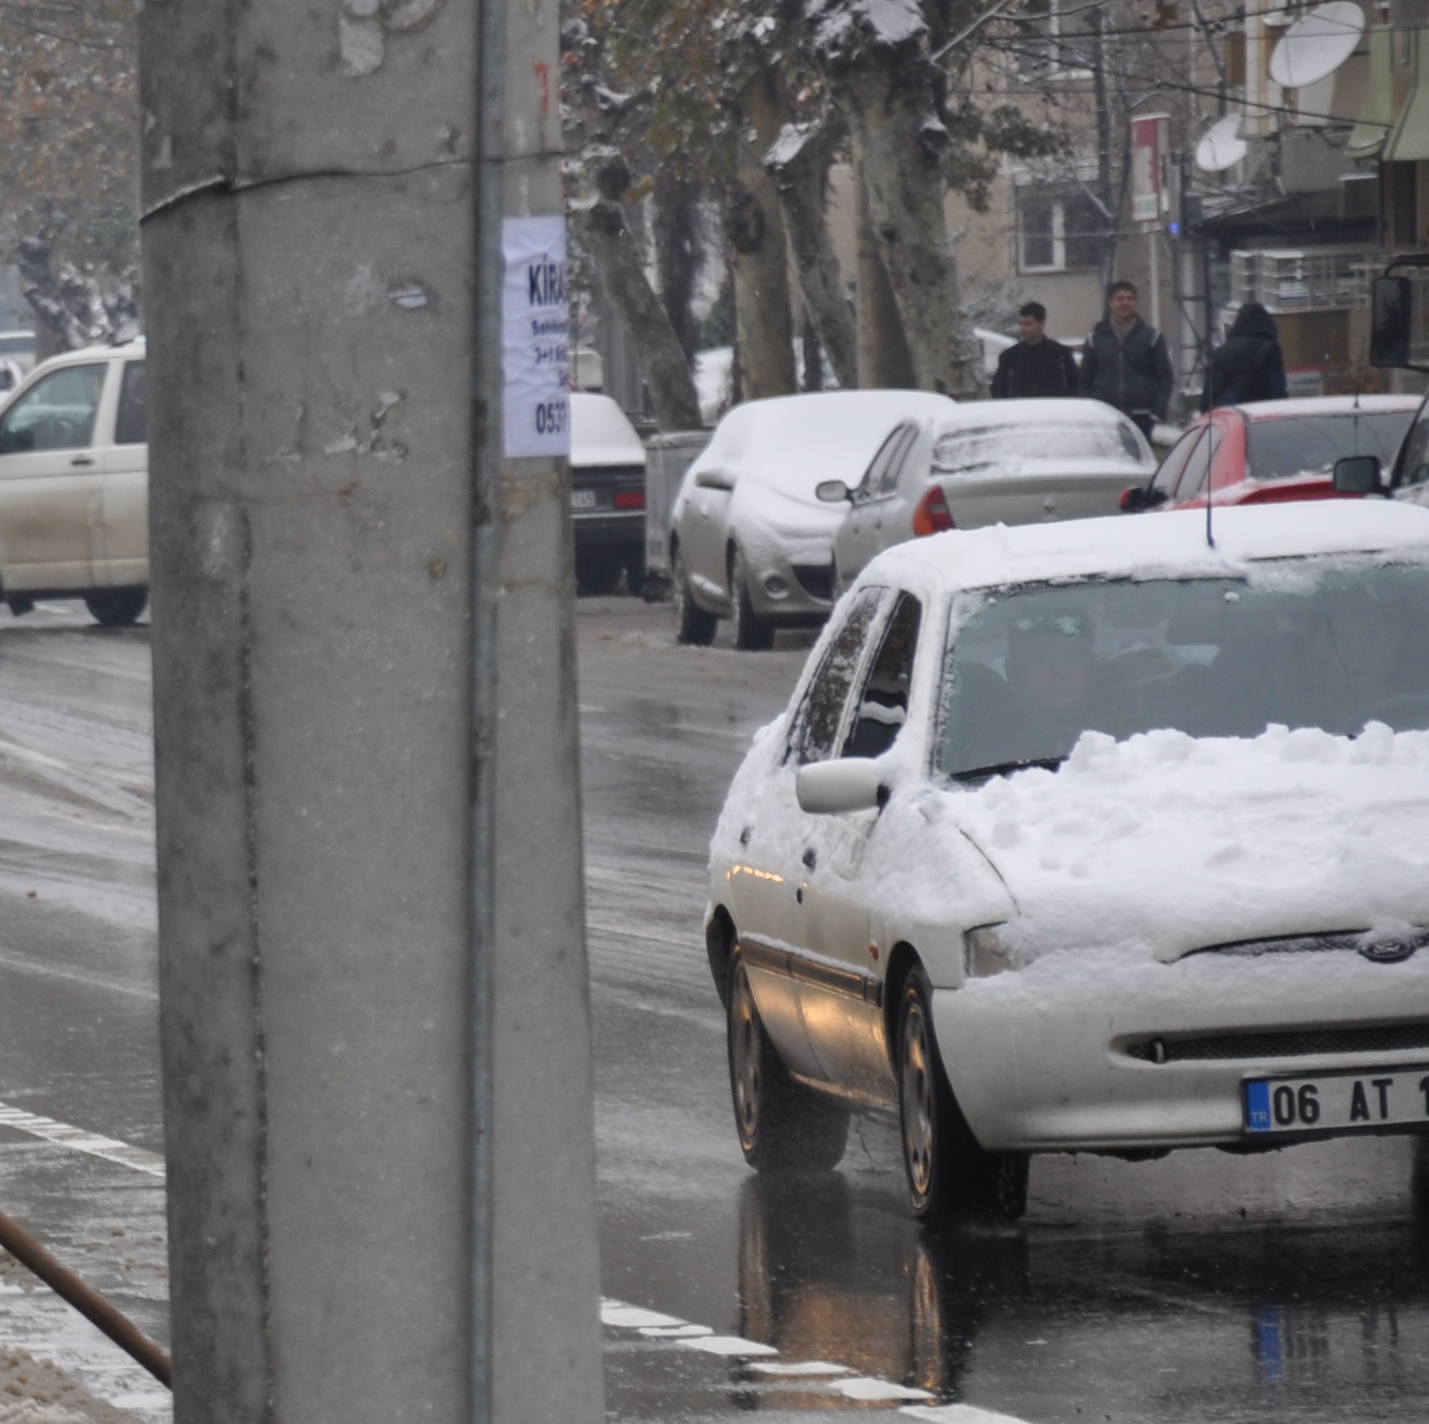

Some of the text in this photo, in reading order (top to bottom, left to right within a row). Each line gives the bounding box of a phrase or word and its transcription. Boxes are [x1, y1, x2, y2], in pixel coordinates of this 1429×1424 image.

[1251, 1111, 1269, 1123] TR
[1273, 1084, 1320, 1126] 06
[1350, 1078, 1394, 1121] AT
